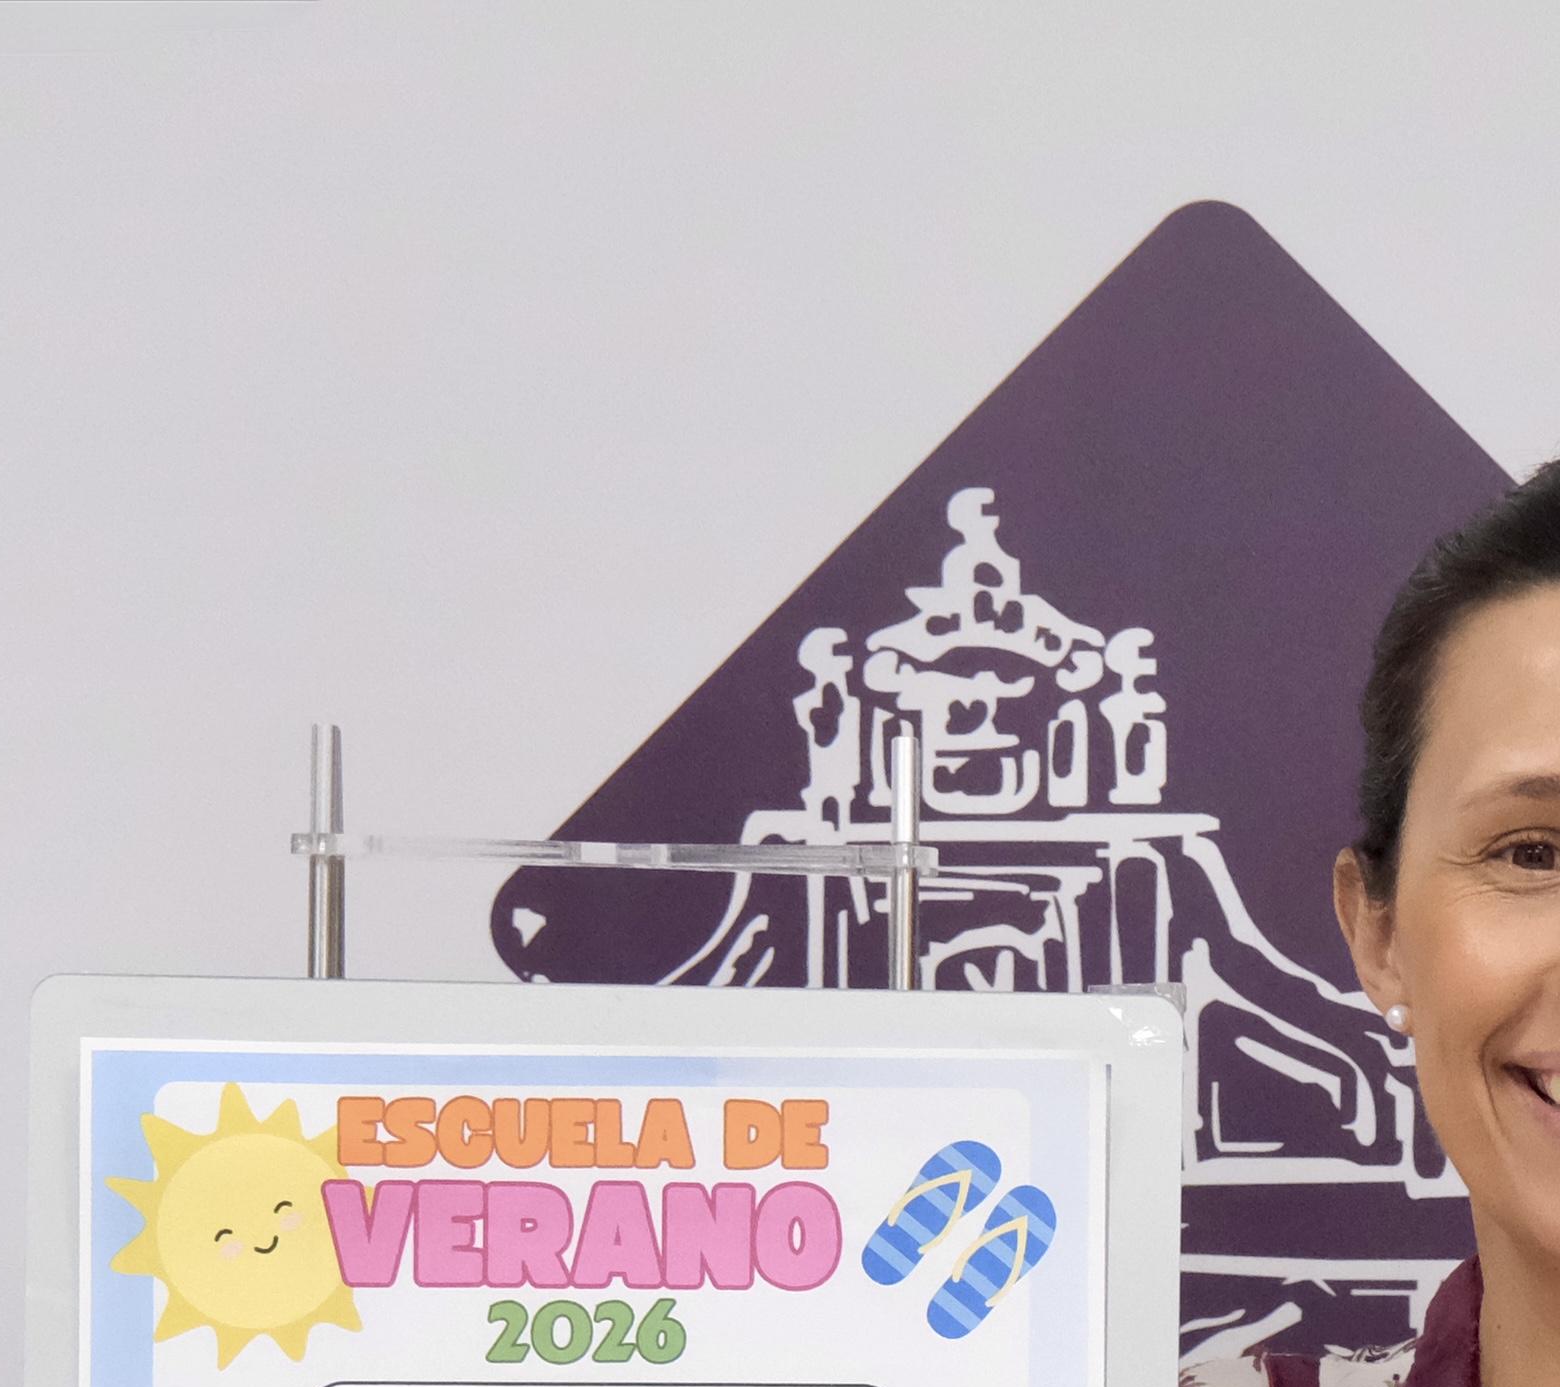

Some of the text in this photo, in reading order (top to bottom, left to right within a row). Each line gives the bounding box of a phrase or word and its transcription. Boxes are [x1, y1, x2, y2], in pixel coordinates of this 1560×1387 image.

[336, 1095, 829, 1170] ESCUELA DE
[321, 1180, 842, 1291] VERANO
[485, 1298, 687, 1365] 2026
